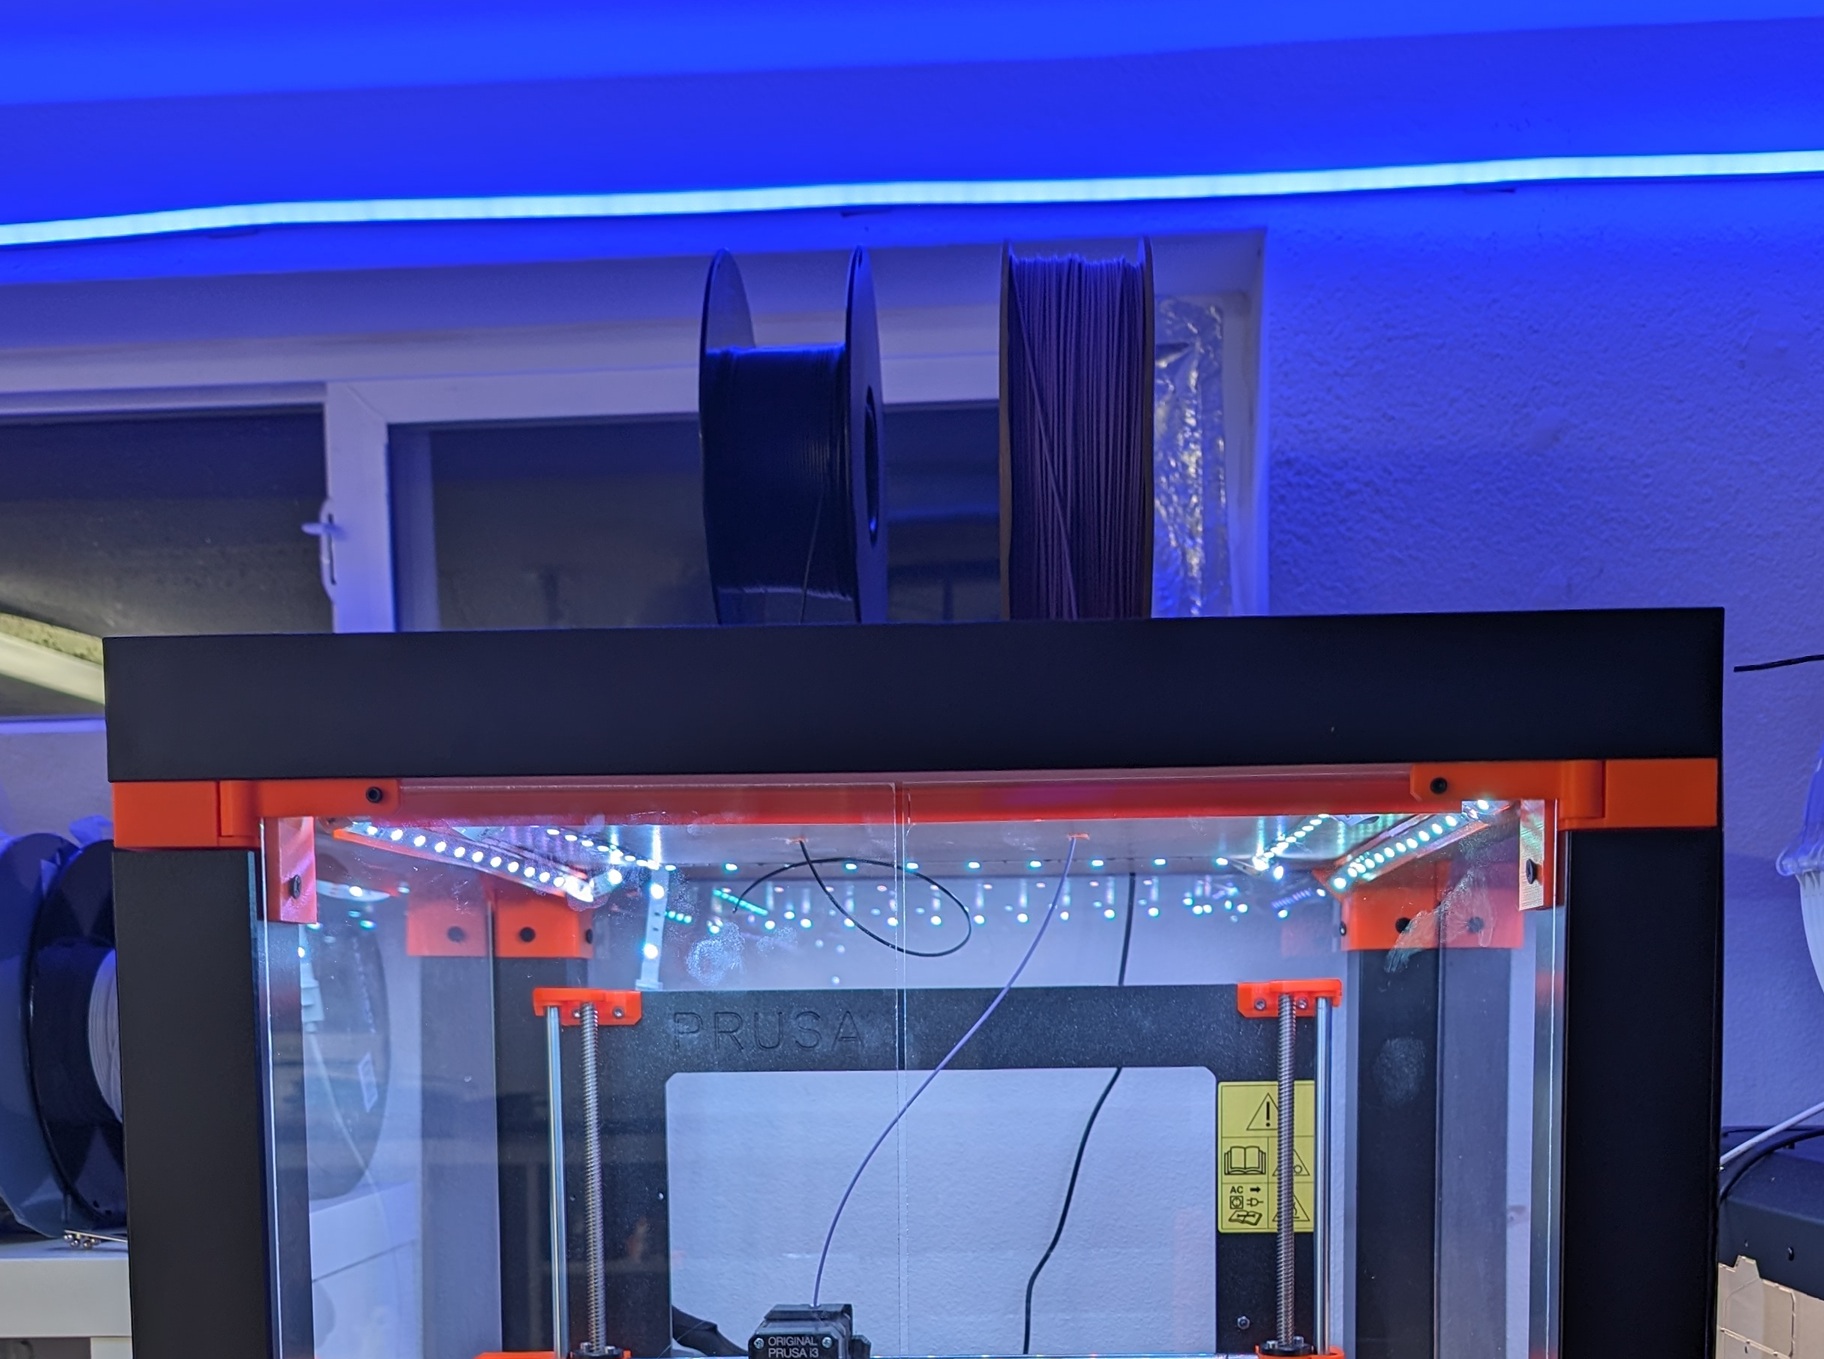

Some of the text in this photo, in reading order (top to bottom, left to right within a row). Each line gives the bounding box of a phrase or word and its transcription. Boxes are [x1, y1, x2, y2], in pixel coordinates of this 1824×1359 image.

[673, 1010, 865, 1052] PRUSA
[1230, 1186, 1244, 1194] AC
[768, 1336, 818, 1347] ORIGINAL
[768, 1348, 807, 1359] PRUSA
